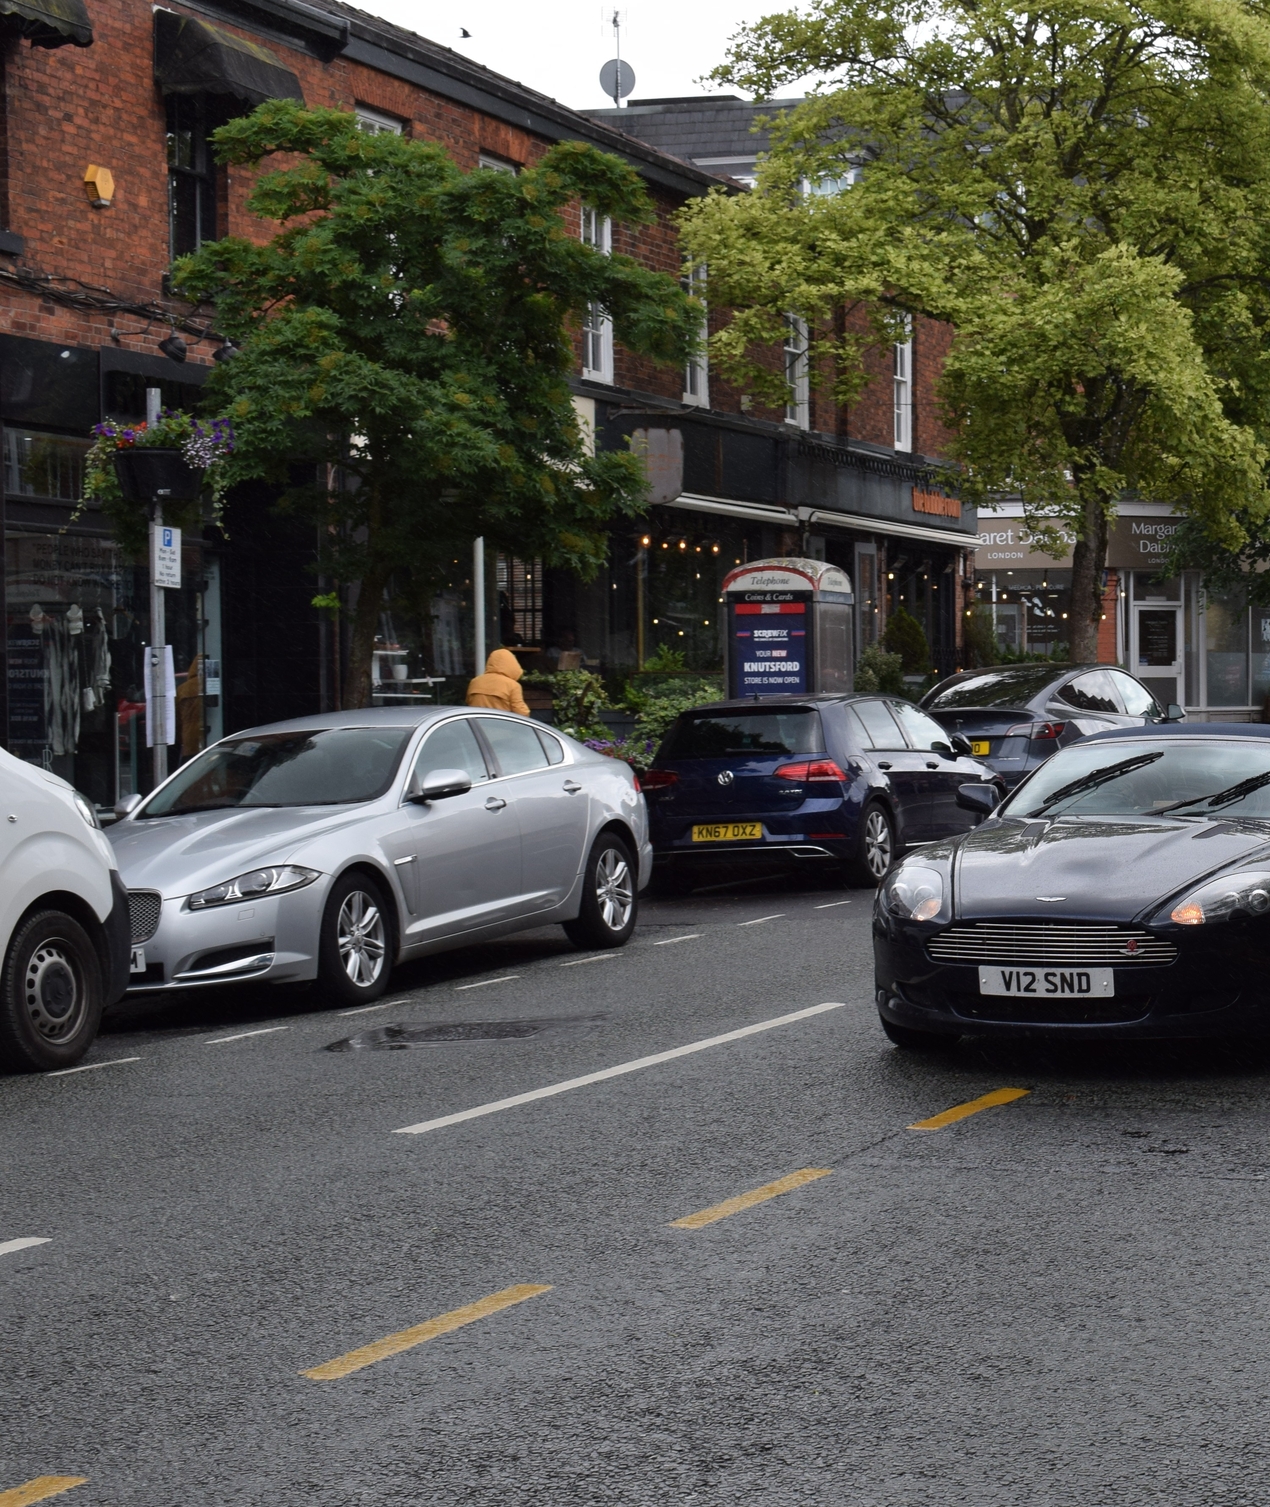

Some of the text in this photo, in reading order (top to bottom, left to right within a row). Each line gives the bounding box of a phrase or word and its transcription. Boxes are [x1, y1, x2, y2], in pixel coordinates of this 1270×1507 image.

[164, 530, 170, 544] P
[977, 528, 1014, 545] aret
[1132, 522, 1178, 540] Margar
[751, 576, 790, 586] Telephone
[754, 630, 788, 638] SCREWFIX
[744, 661, 800, 672] KNUTSFORD
[697, 825, 756, 838] KN67 OXZ
[1001, 970, 1091, 994] V12 SND
